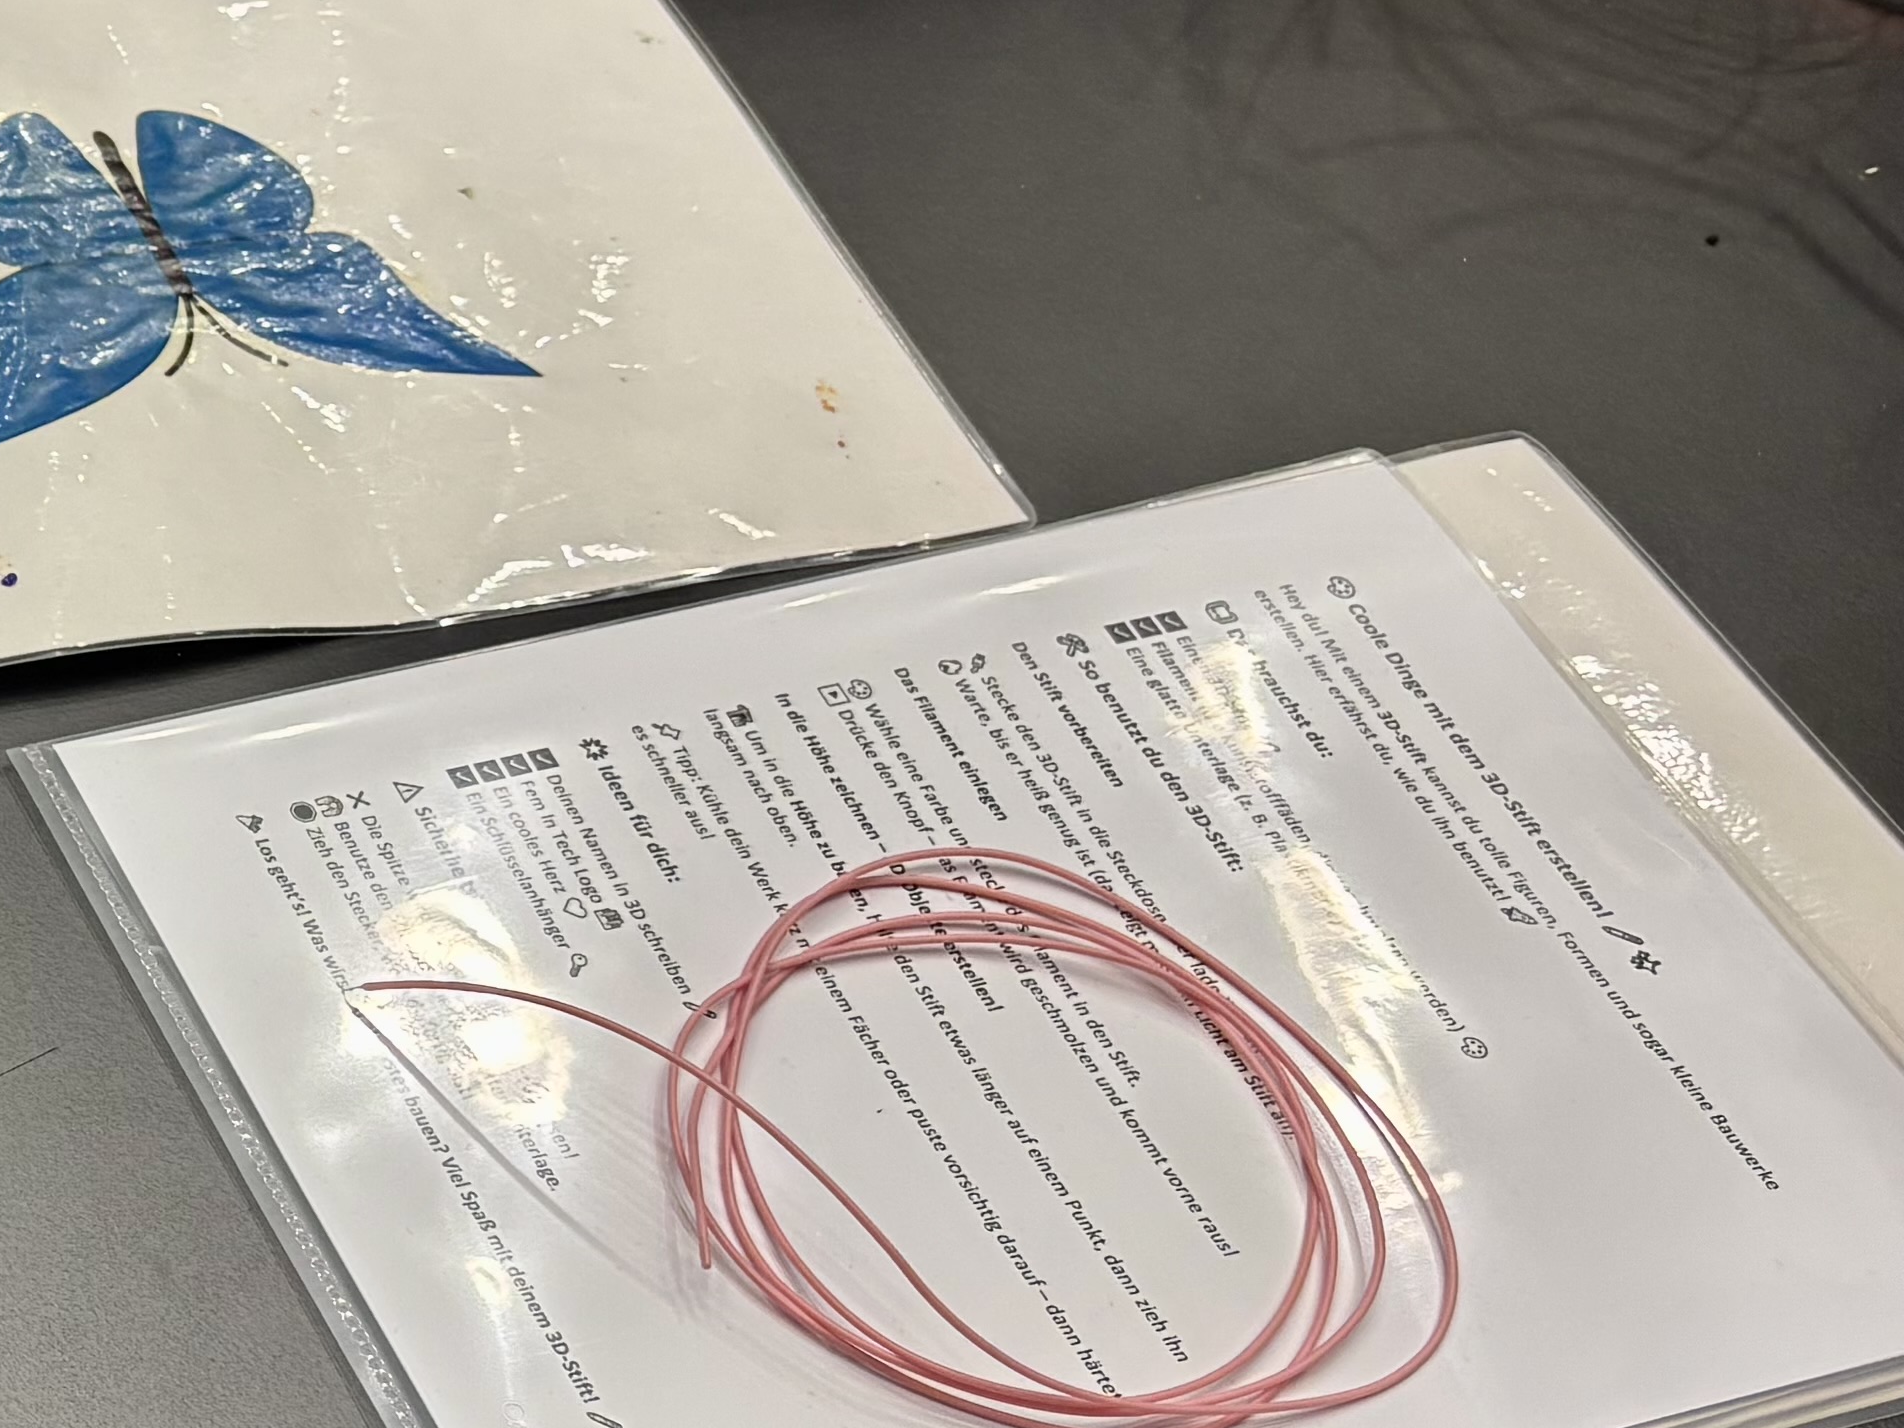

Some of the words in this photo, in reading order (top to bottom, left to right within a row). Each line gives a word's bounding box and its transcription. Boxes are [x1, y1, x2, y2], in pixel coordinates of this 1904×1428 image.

[1010, 641, 1041, 672] Den
[1032, 672, 1065, 704] Stift
[1055, 704, 1127, 789] vorbereiten
[1124, 647, 1156, 678] Eine
[640, 743, 695, 807] schneller
[683, 809, 718, 841] aus!
[701, 708, 751, 768] langsam
[741, 769, 775, 805] nach
[765, 806, 802, 849] oben.
[912, 695, 968, 759] Filament
[956, 760, 1011, 822] einlegen
[979, 676, 1023, 723] Stecke
[1034, 753, 1085, 807] 3D-Stift
[1093, 682, 1151, 746] benutzt
[1158, 771, 1193, 803] den
[1184, 804, 1247, 874] 3D-Stift:
[1251, 589, 1309, 654] erstellen.
[1302, 654, 1335, 684] Hier
[1326, 686, 1380, 741] erfährst
[1451, 841, 1513, 903] benutzt!
[1304, 731, 1337, 759] du:
[1346, 603, 1393, 651] Coole
[1382, 652, 1431, 700] Dinge
[1422, 702, 1457, 732] mit
[1447, 733, 1489, 771] dem
[1479, 772, 1544, 838] 3D-Stift
[1535, 838, 1615, 920] erstellen!
[305, 828, 336, 859] Zieh
[324, 861, 353, 890] den
[332, 821, 379, 881] Benutze
[368, 883, 397, 912] den
[374, 841, 413, 887] Spitze
[477, 817, 575, 951] Schlüsselanhänger
[507, 812, 547, 859] cooles
[537, 859, 569, 894] Herz
[520, 780, 549, 812] Fem
[550, 830, 583, 867] Tech
[572, 868, 606, 905] Logo
[545, 774, 588, 826] Deinen
[578, 827, 622, 881] Namen
[636, 922, 694, 996] schreiben
[596, 765, 638, 813] Ideen
[645, 842, 684, 884] dich:
[801, 735, 839, 775] Höhe
[828, 776, 883, 842] zeichnen
[941, 939, 1006, 1013] erstellen!
[863, 702, 905, 750] Wähle
[894, 751, 927, 783] eine
[918, 784, 956, 826] Farbe
[1084, 1019, 1116, 1050] den
[1107, 1050, 1144, 1089] Stift.
[953, 678, 995, 728] Warte,
[1016, 769, 1051, 802] heiß
[1037, 803, 1083, 849] genug
[1243, 1075, 1281, 1109] Stift
[1276, 583, 1309, 611] Hey
[1341, 666, 1384, 710] einem
[1375, 710, 1430, 765] 3D-Stift
[1420, 766, 1469, 814] kannst
[1477, 836, 1514, 870] tolle
[1505, 871, 1561, 931] Figuren,
[1556, 931, 1612, 989] Formen
[1605, 990, 1643, 1021] und
[1631, 1022, 1676, 1064] sogar
[1669, 1065, 1716, 1112] kleine
[1708, 1114, 1782, 1191] Bauwerke
[670, 746, 705, 784] Tipp:
[694, 784, 732, 826] Kühle
[723, 828, 754, 860] dein
[746, 861, 783, 902] Werk
[814, 966, 856, 1014] einem
[846, 1015, 893, 1067] Fächer
[882, 1069, 919, 1106] oder
[907, 1108, 950, 1153] puste
[941, 1154, 1006, 1234] vorsichtig
[995, 1233, 1048, 1288] darauf
[1045, 1304, 1085, 1347] dann
[837, 709, 882, 760] Drücke
[891, 791, 936, 834] Knopf
[998, 940, 1034, 975] wird
[1020, 977, 1102, 1075] geschmolzen
[1094, 1076, 1130, 1108] und
[1118, 1108, 1170, 1167] kommt
[1161, 1167, 1205, 1215] vorne
[1197, 1216, 1239, 1258] raus!
[789, 800, 826, 840] Höhe
[893, 952, 923, 985] den
[914, 985, 947, 1019] Stift
[937, 1020, 979, 1066] etwas
[969, 1067, 1016, 1117] länger
[1006, 1119, 1040, 1145] auf
[1027, 1148, 1072, 1198] einem
[1063, 1199, 1109, 1253] Punkt,
[1102, 1254, 1143, 1297] dann
[1134, 1299, 1170, 1334] zieh
[1161, 1335, 1191, 1364] ihn
[301, 918, 331, 954] Was
[402, 1096, 452, 1156] bauen?
[440, 1156, 473, 1189] Viel
[457, 1190, 498, 1234] Spaß
[486, 1234, 516, 1264] mit
[505, 1266, 554, 1330] deinem
[544, 1331, 603, 1405] 3D-Stift!
